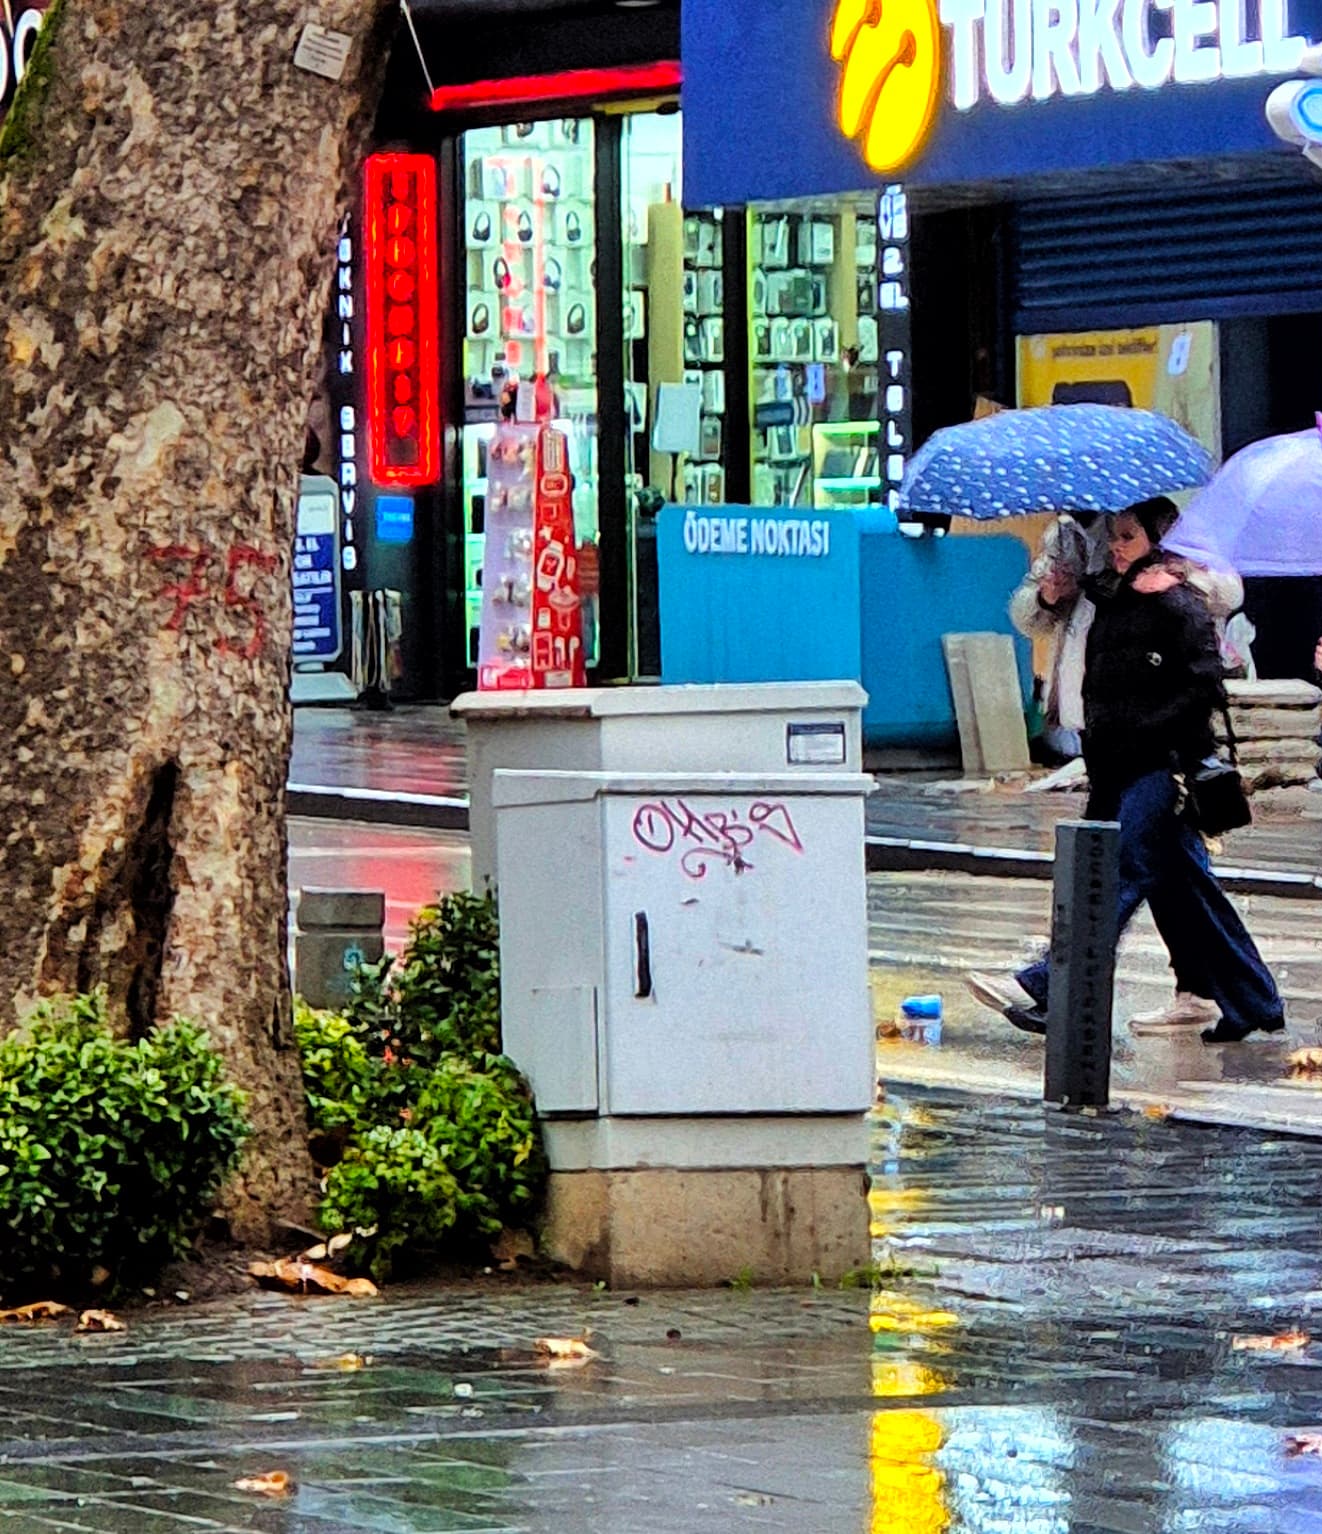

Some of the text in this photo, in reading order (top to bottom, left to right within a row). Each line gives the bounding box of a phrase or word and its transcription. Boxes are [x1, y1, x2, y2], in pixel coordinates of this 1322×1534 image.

[940, 0, 1306, 110] TURKCELL
[684, 510, 830, 557] ÖDEME NOKTASI
